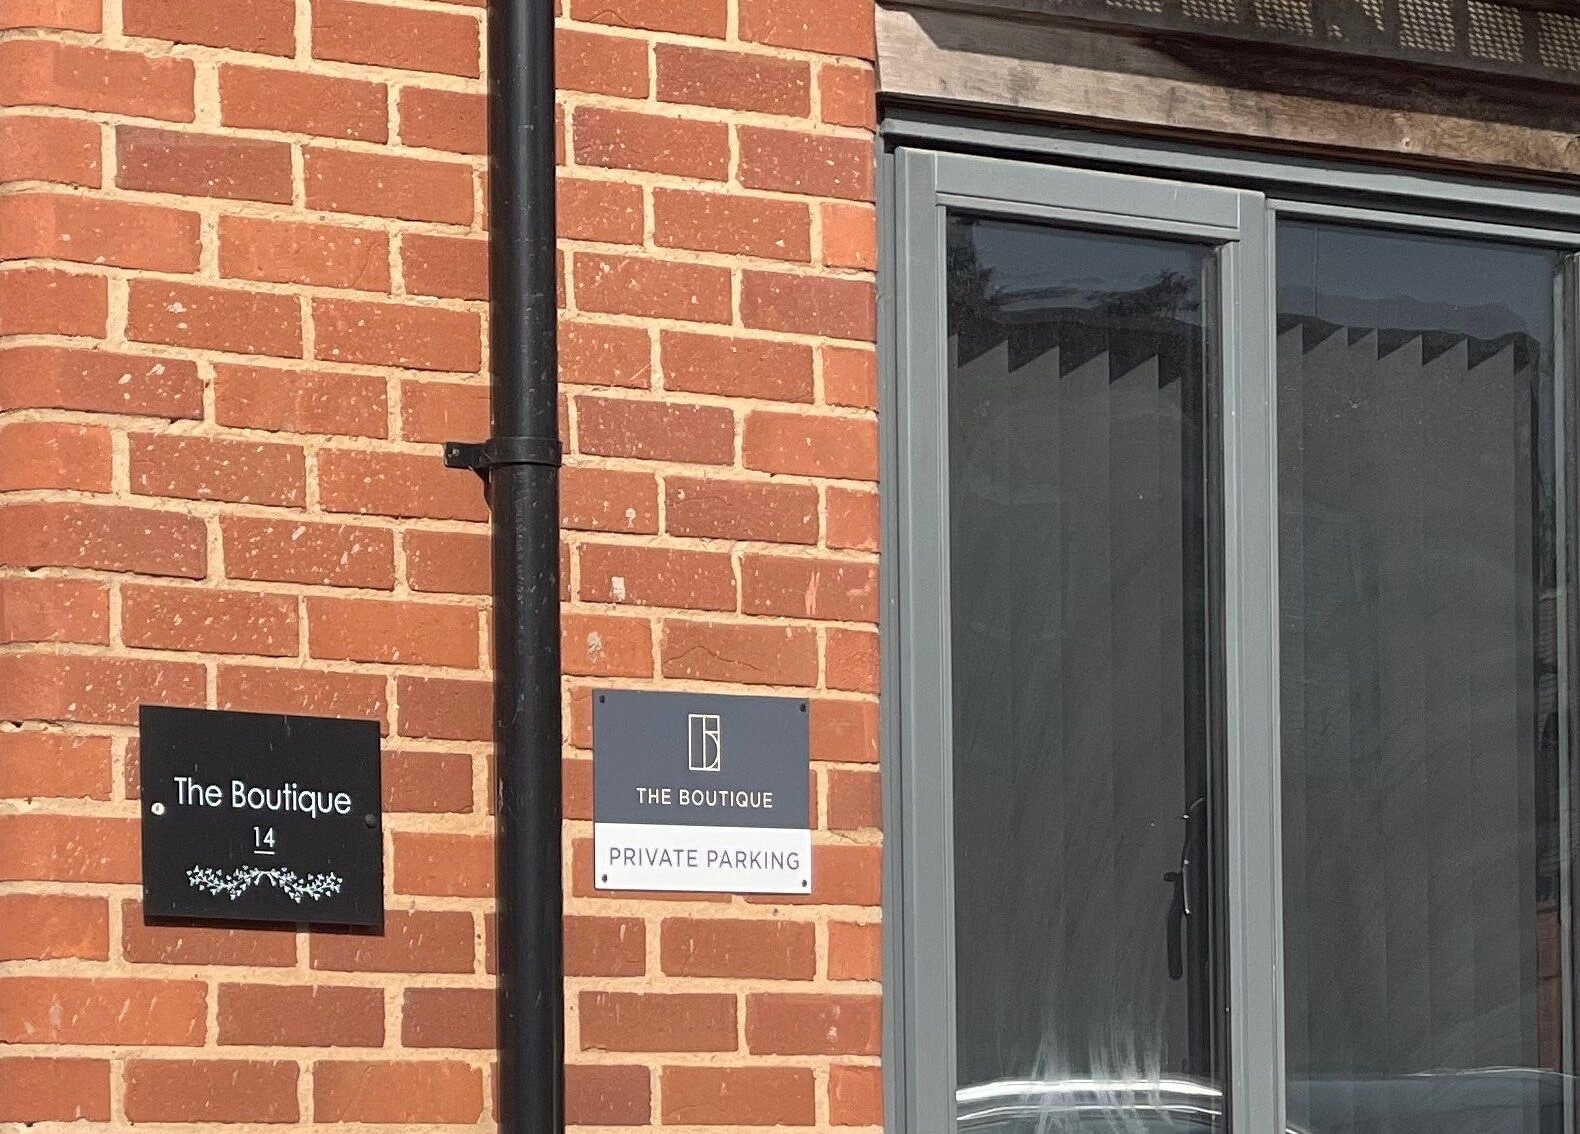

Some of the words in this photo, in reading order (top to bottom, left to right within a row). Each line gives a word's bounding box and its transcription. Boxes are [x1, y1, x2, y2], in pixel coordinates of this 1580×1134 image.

[173, 776, 222, 807] The
[231, 780, 352, 818] Boutique
[636, 787, 672, 805] THE
[679, 789, 773, 808] BOUTIQUE
[253, 826, 276, 848] 14
[609, 847, 698, 868] PRIVATE
[707, 850, 800, 870] PARKING
